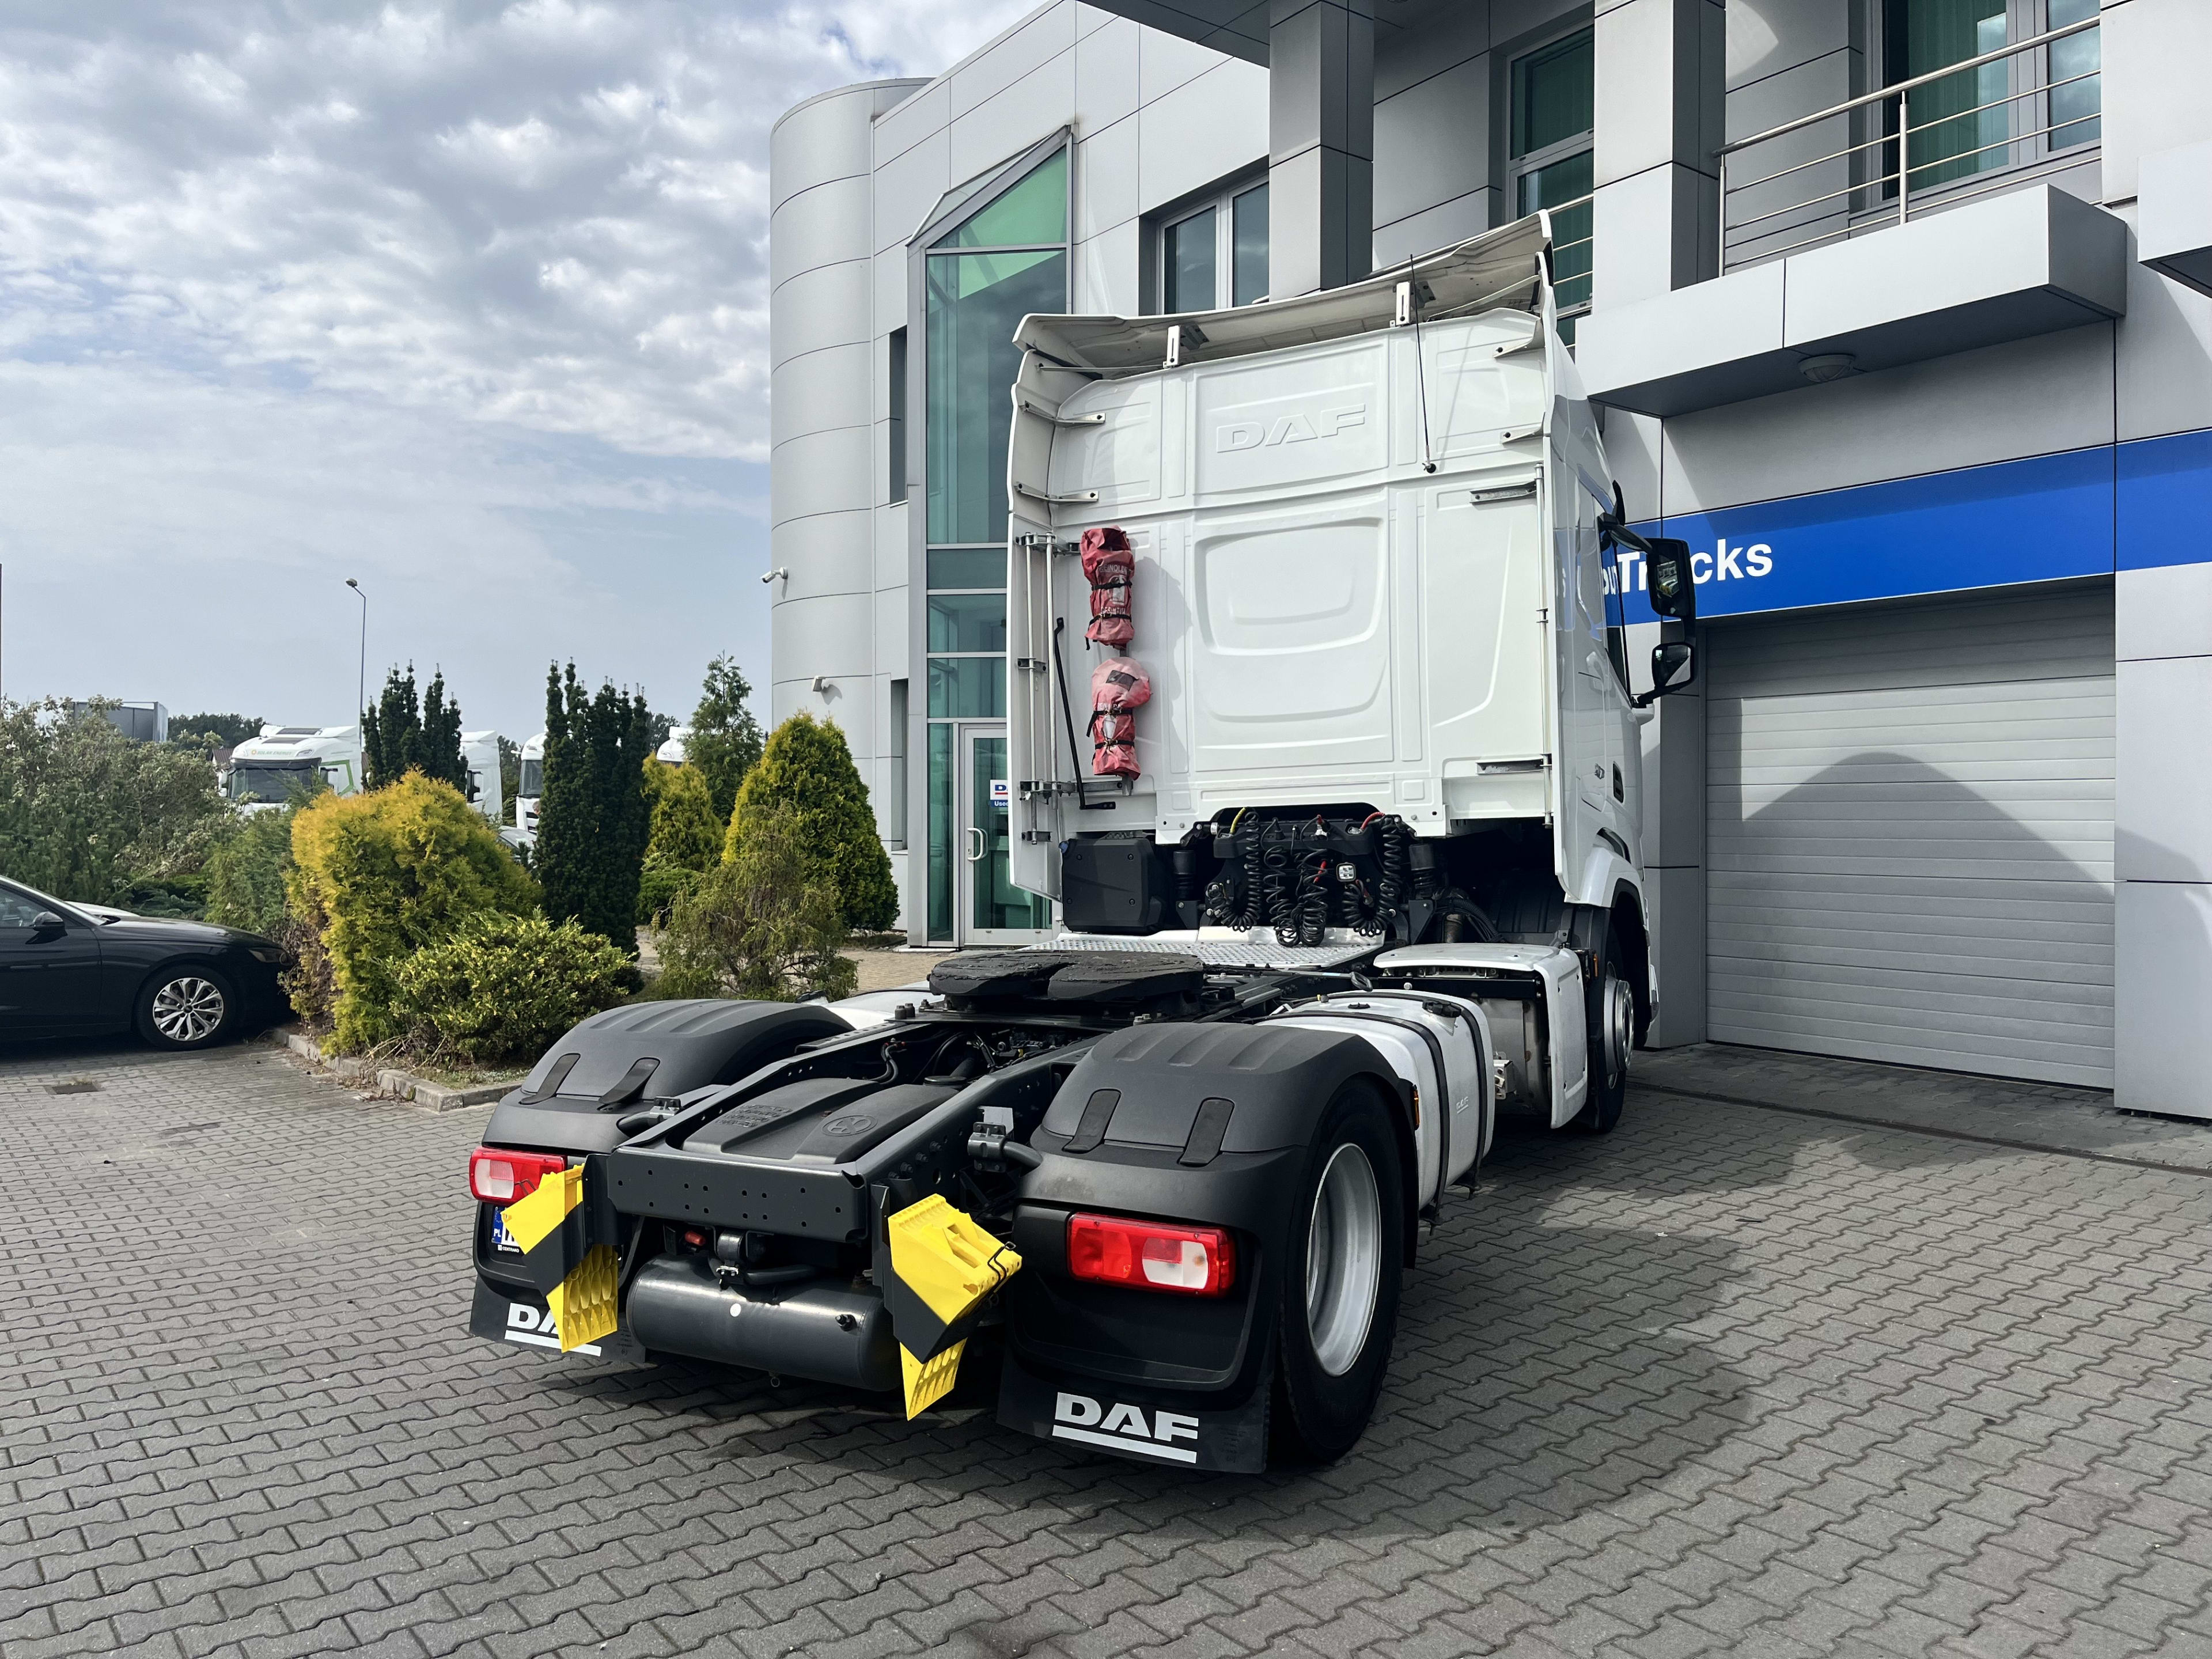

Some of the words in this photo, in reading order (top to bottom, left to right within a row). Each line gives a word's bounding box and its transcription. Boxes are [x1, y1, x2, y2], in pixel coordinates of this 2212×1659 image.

[1216, 403, 1366, 453] DAF
[1617, 539, 1773, 593] Trcks
[493, 1228, 502, 1238] PL
[1055, 1392, 1199, 1442] DAF
